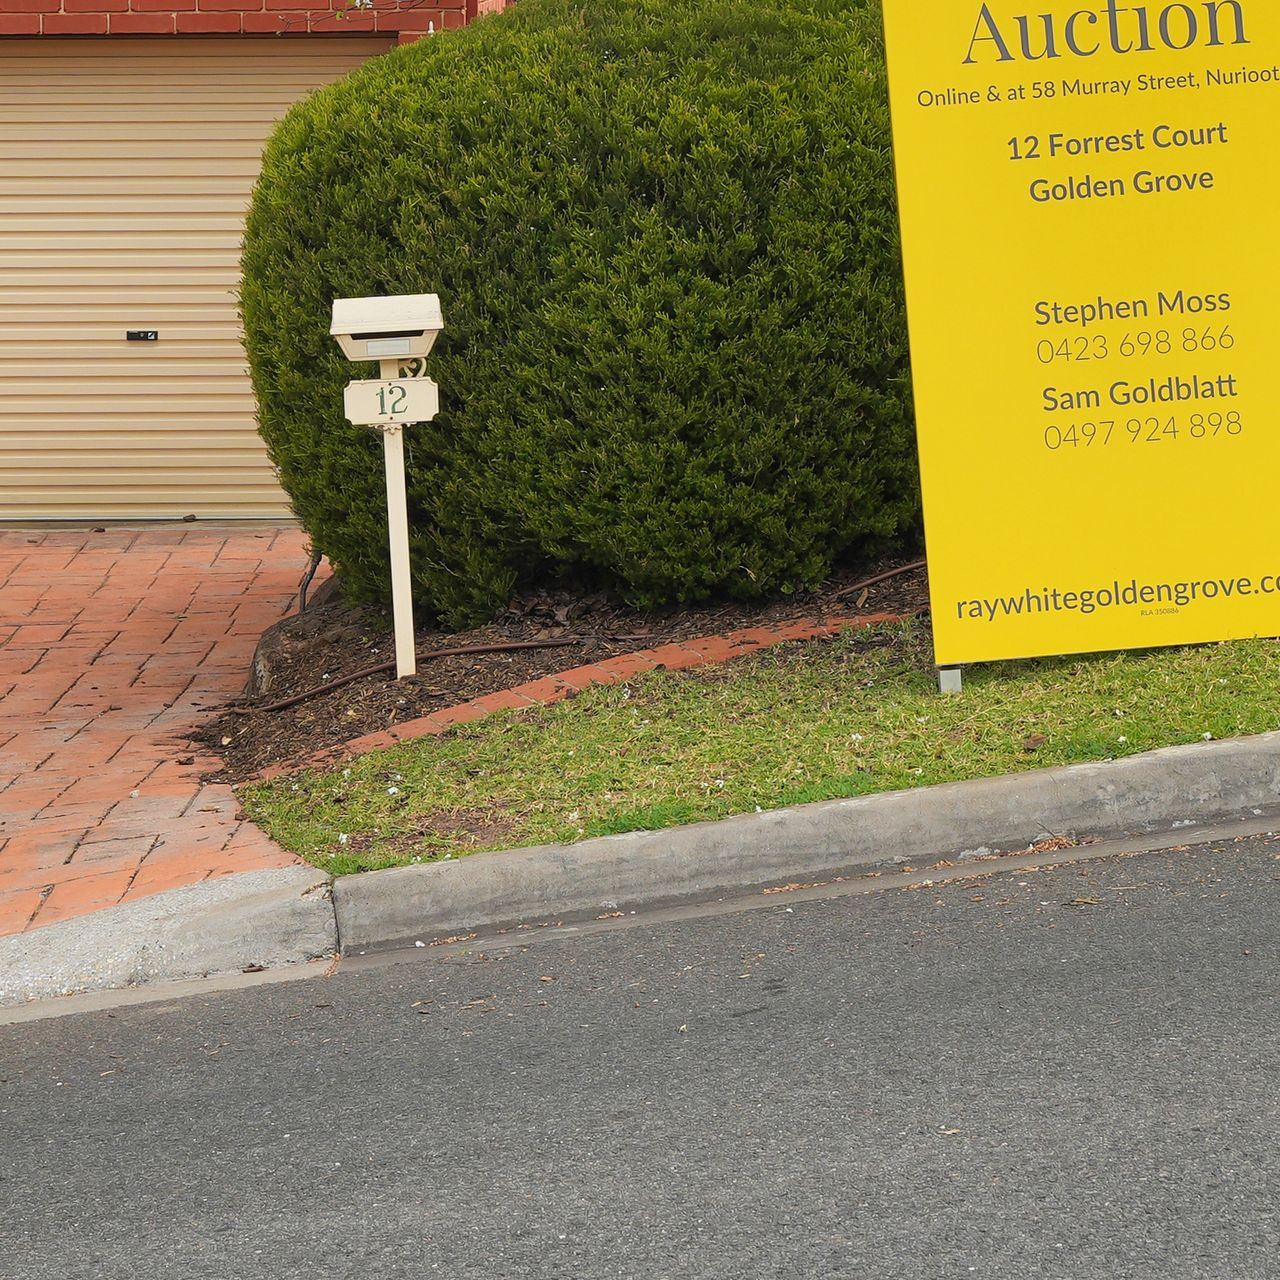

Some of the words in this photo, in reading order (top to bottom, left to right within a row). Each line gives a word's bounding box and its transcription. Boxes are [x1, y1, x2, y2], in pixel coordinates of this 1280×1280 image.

[917, 88, 981, 108] Online
[987, 85, 1002, 103] &
[1007, 83, 1027, 101] at
[1031, 81, 1056, 99] 58
[1062, 79, 1132, 97] Murray
[1137, 70, 1201, 91] Street,
[1007, 136, 1041, 161] 12
[1048, 129, 1146, 157] Forrest
[1152, 122, 1229, 149] Court
[1029, 175, 1125, 203] Golden
[1132, 170, 1214, 194] Grove
[1034, 296, 1149, 326] Stephen
[1157, 289, 1231, 316] Moss
[1036, 334, 1109, 364] 0423
[1119, 329, 1172, 358] 698
[1182, 324, 1235, 352] 866
[376, 385, 408, 416] 12
[1042, 387, 1101, 412] Sam
[1108, 373, 1239, 406] Goldblatt
[1044, 421, 1116, 450] 0497
[1126, 416, 1180, 444] 924
[1189, 411, 1243, 438] 898
